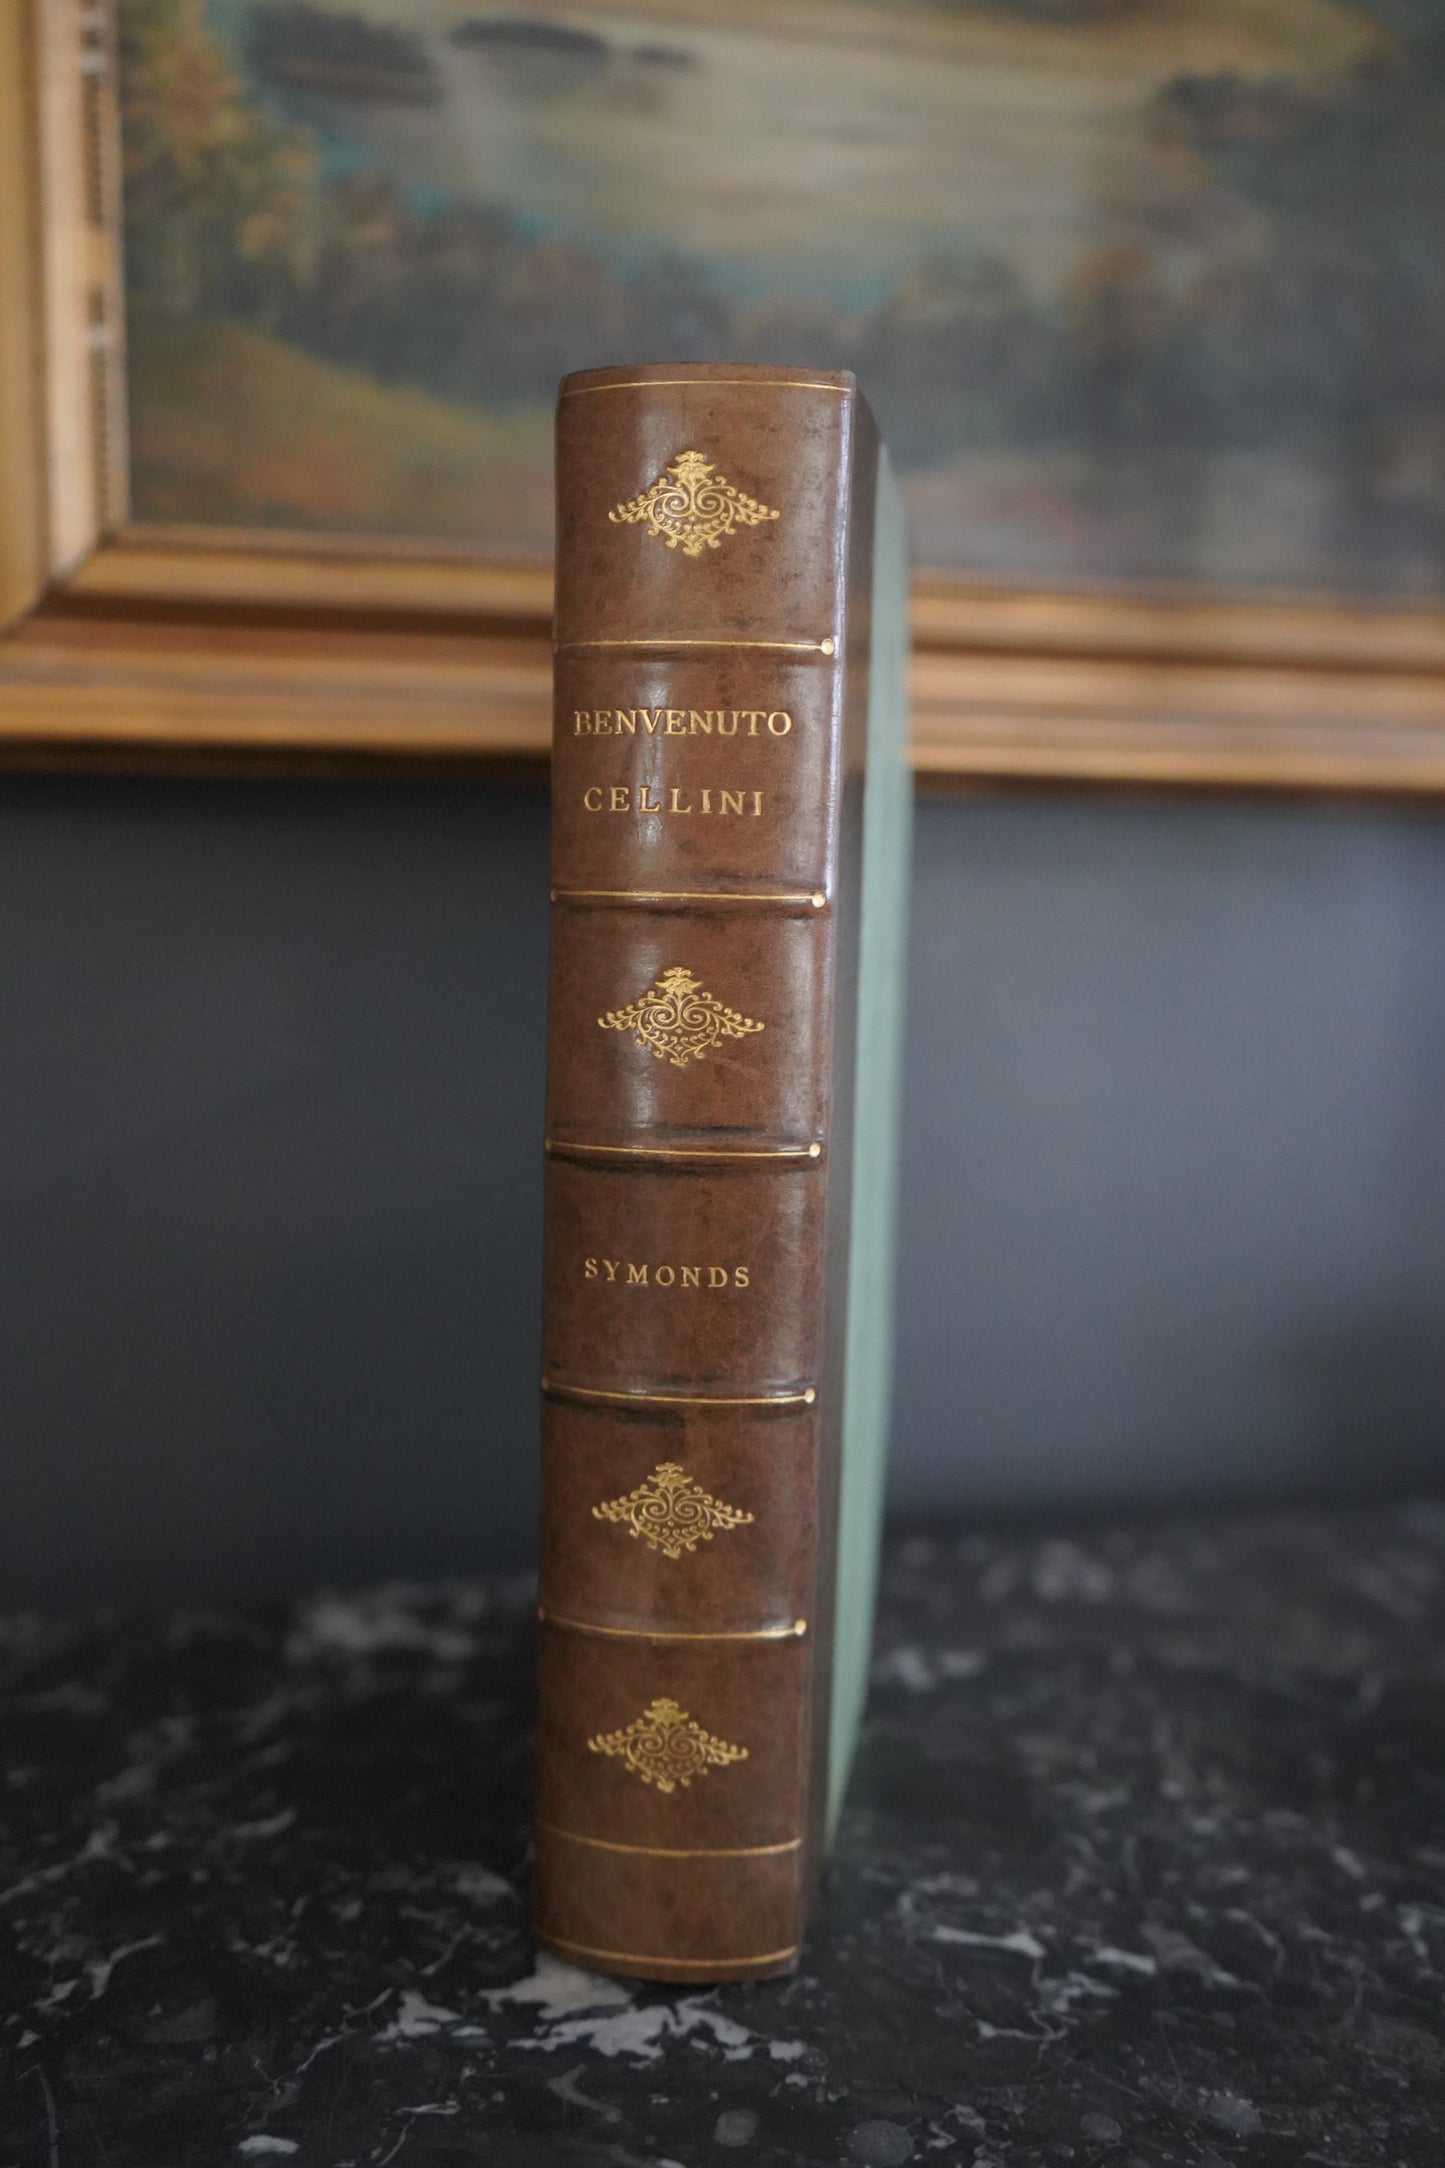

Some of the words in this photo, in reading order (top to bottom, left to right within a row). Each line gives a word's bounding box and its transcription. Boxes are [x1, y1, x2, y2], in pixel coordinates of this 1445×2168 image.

[574, 708, 792, 736] BENVENUTO
[584, 786, 765, 816] CELLINI
[584, 1257, 750, 1288] SYMONDS
